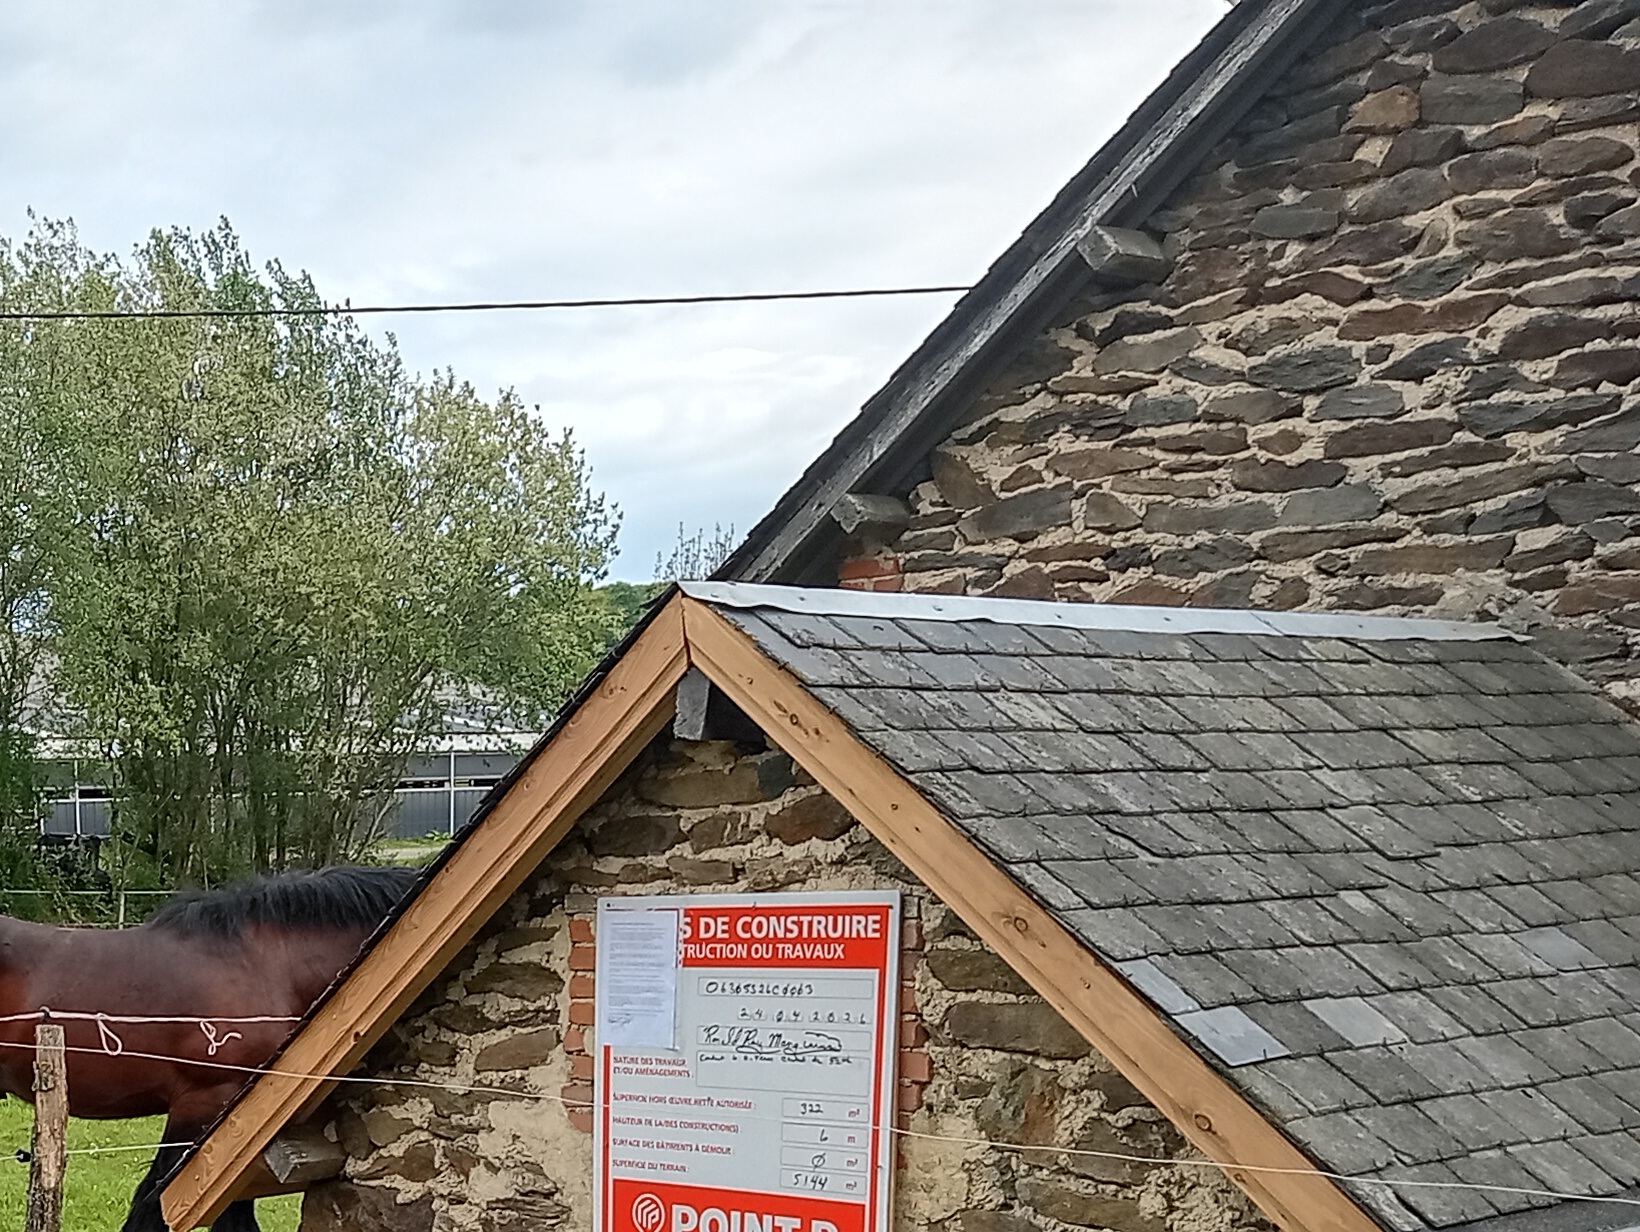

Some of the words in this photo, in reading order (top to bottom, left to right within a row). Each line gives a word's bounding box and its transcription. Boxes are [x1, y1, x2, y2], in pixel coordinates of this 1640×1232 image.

[699, 916, 730, 938] DE
[736, 915, 881, 939] CONSTRUIRE
[751, 943, 772, 959] OU
[776, 943, 845, 960] TRAVAUX
[613, 1056, 639, 1065] NATURE
[641, 1057, 653, 1066] DES
[654, 1058, 686, 1067] TRAVAUX
[649, 1096, 667, 1104] HORS
[801, 1103, 824, 1115] 322
[612, 1116, 642, 1126] HAUTEUR
[644, 1118, 653, 1127] DE
[819, 1129, 828, 1142] 6
[612, 1138, 640, 1148] SURFACE
[642, 1140, 655, 1149] DES
[647, 1162, 658, 1171] DU
[793, 1173, 828, 1190] 5144
